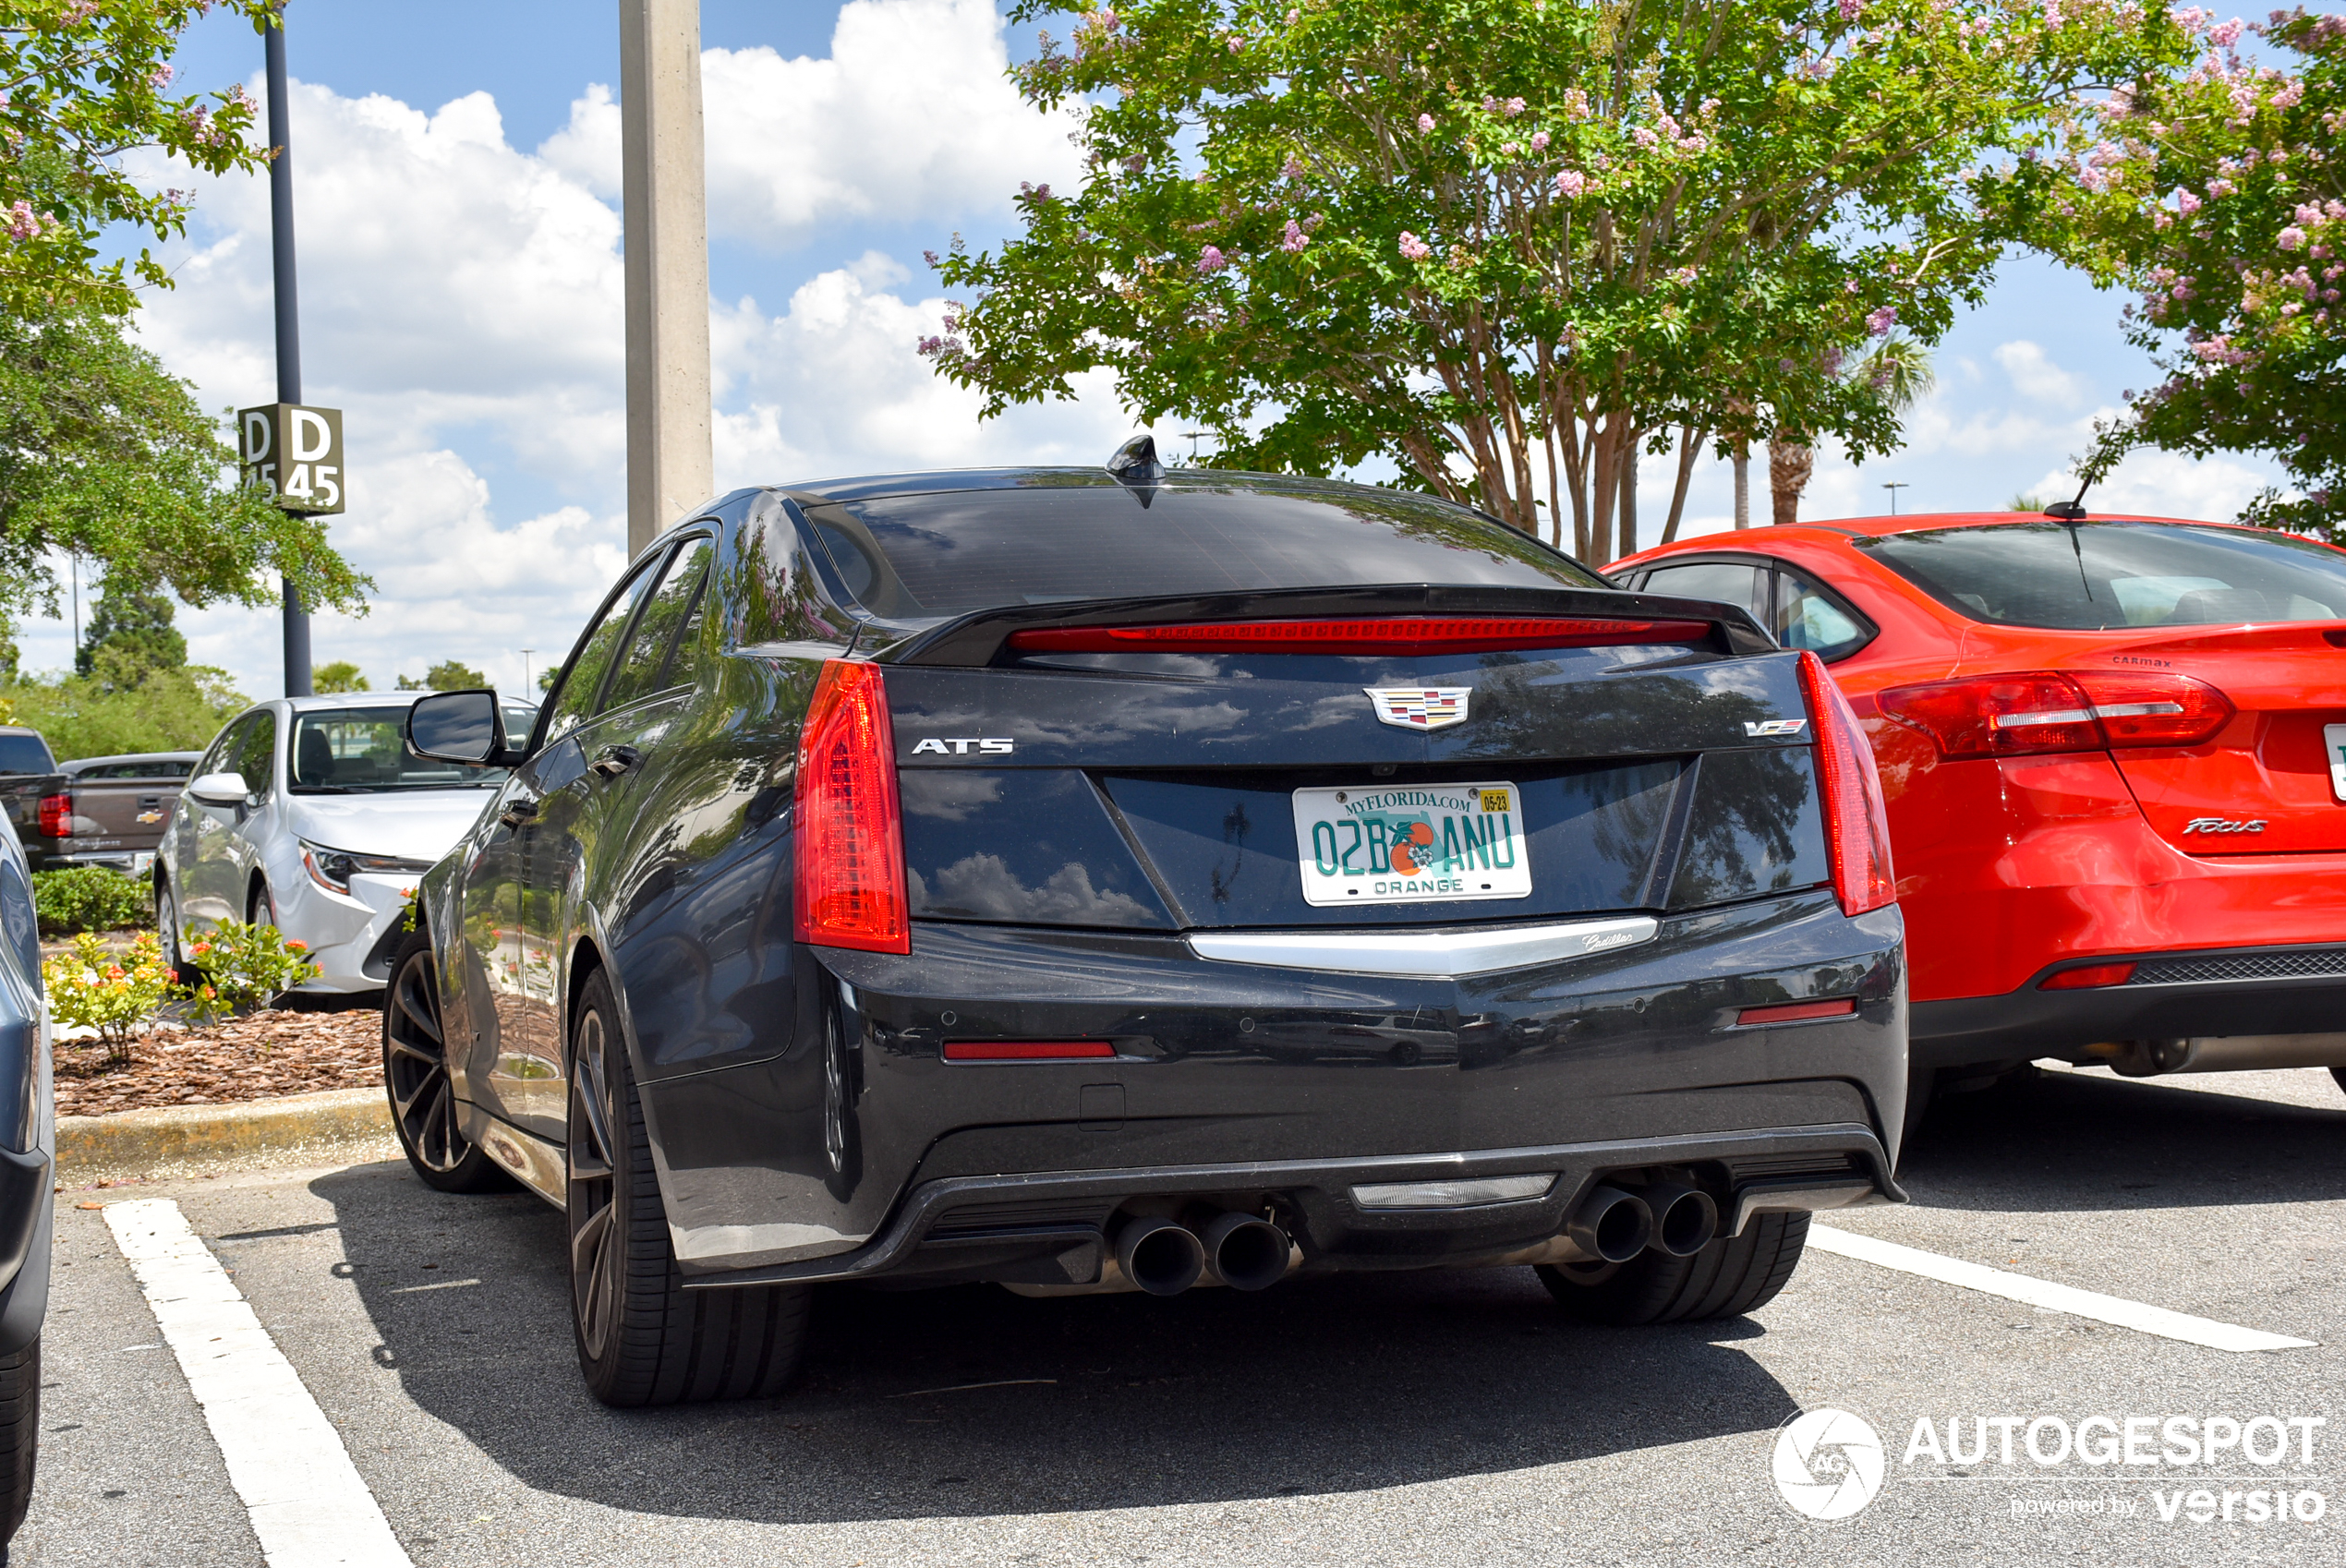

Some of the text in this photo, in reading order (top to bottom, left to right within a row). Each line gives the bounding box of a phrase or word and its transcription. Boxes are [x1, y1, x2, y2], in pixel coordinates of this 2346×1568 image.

[245, 411, 272, 463] D
[291, 408, 332, 462] D
[284, 464, 340, 507] 45
[911, 738, 1014, 754] ATS
[1344, 791, 1471, 816] MYFLORIDA.COM
[1483, 795, 1507, 811] 05-23
[1444, 814, 1515, 872] ANU
[1374, 878, 1464, 894] ORANGE
[1581, 933, 1633, 952] Cadillac
